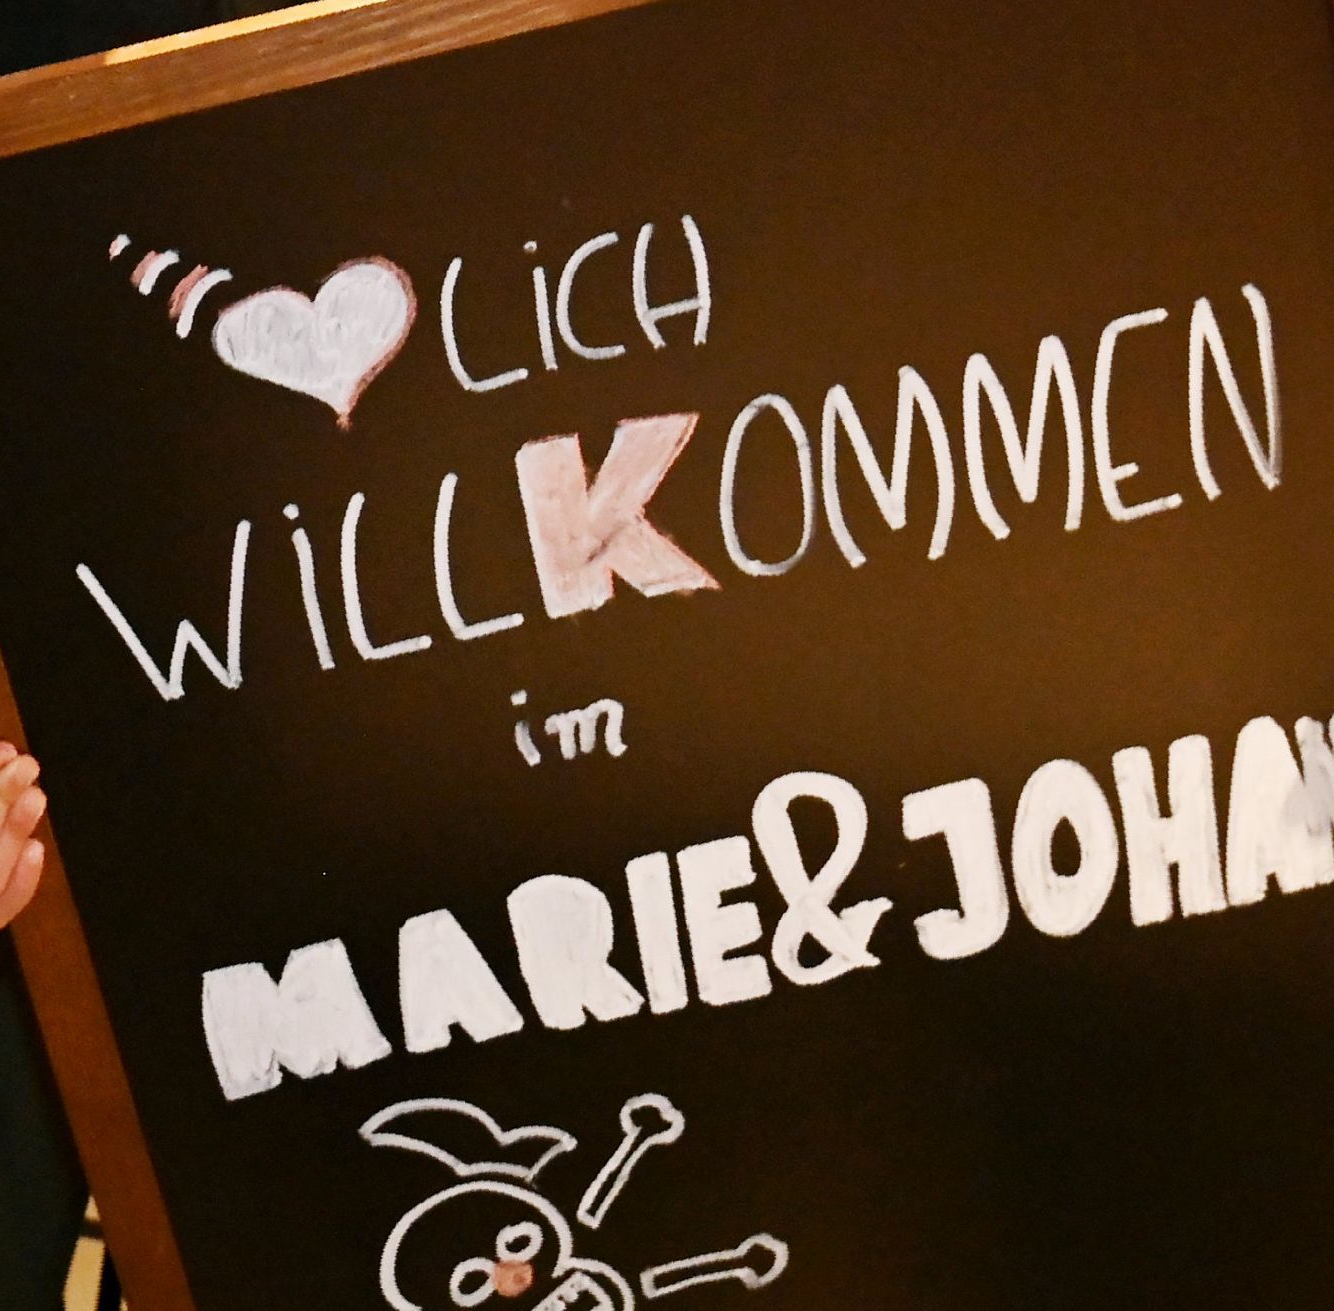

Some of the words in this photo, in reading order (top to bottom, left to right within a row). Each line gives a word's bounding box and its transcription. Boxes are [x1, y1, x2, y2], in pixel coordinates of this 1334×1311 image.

[510, 689, 629, 767] im
[201, 835, 773, 1101] MARIE
[751, 771, 894, 986] &
